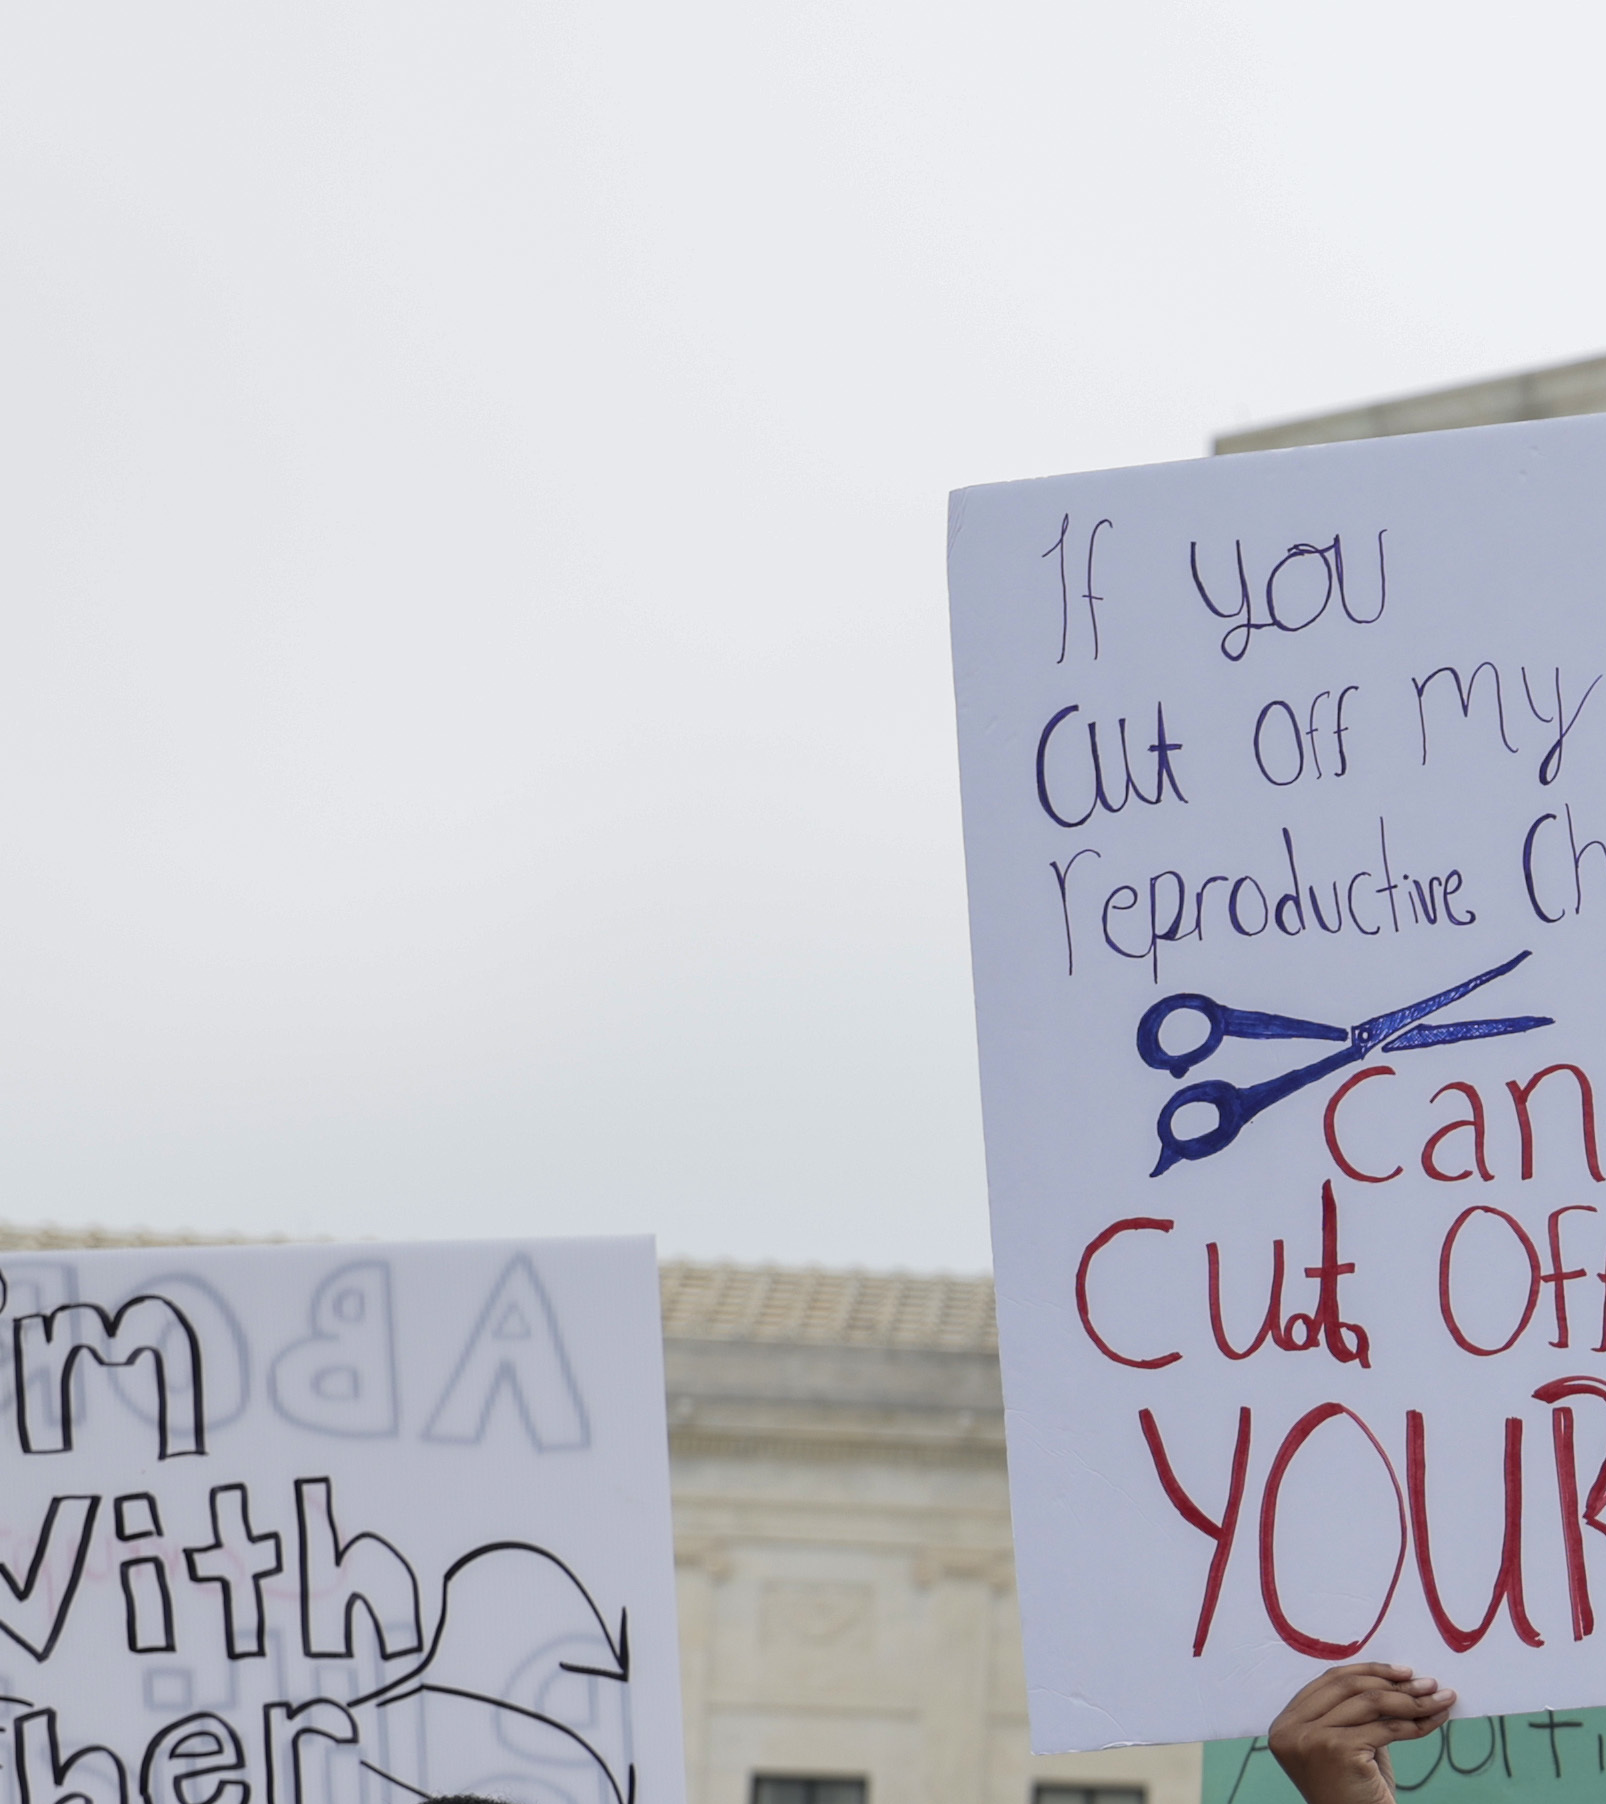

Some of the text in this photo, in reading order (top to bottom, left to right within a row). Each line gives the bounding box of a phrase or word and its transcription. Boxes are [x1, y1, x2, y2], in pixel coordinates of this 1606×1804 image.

[1041, 513, 1113, 664] If
[1035, 700, 1190, 829] Cut
[1252, 685, 1360, 788] Off
[1049, 816, 1477, 985] reproductive
[1322, 1063, 1606, 1184] Can
